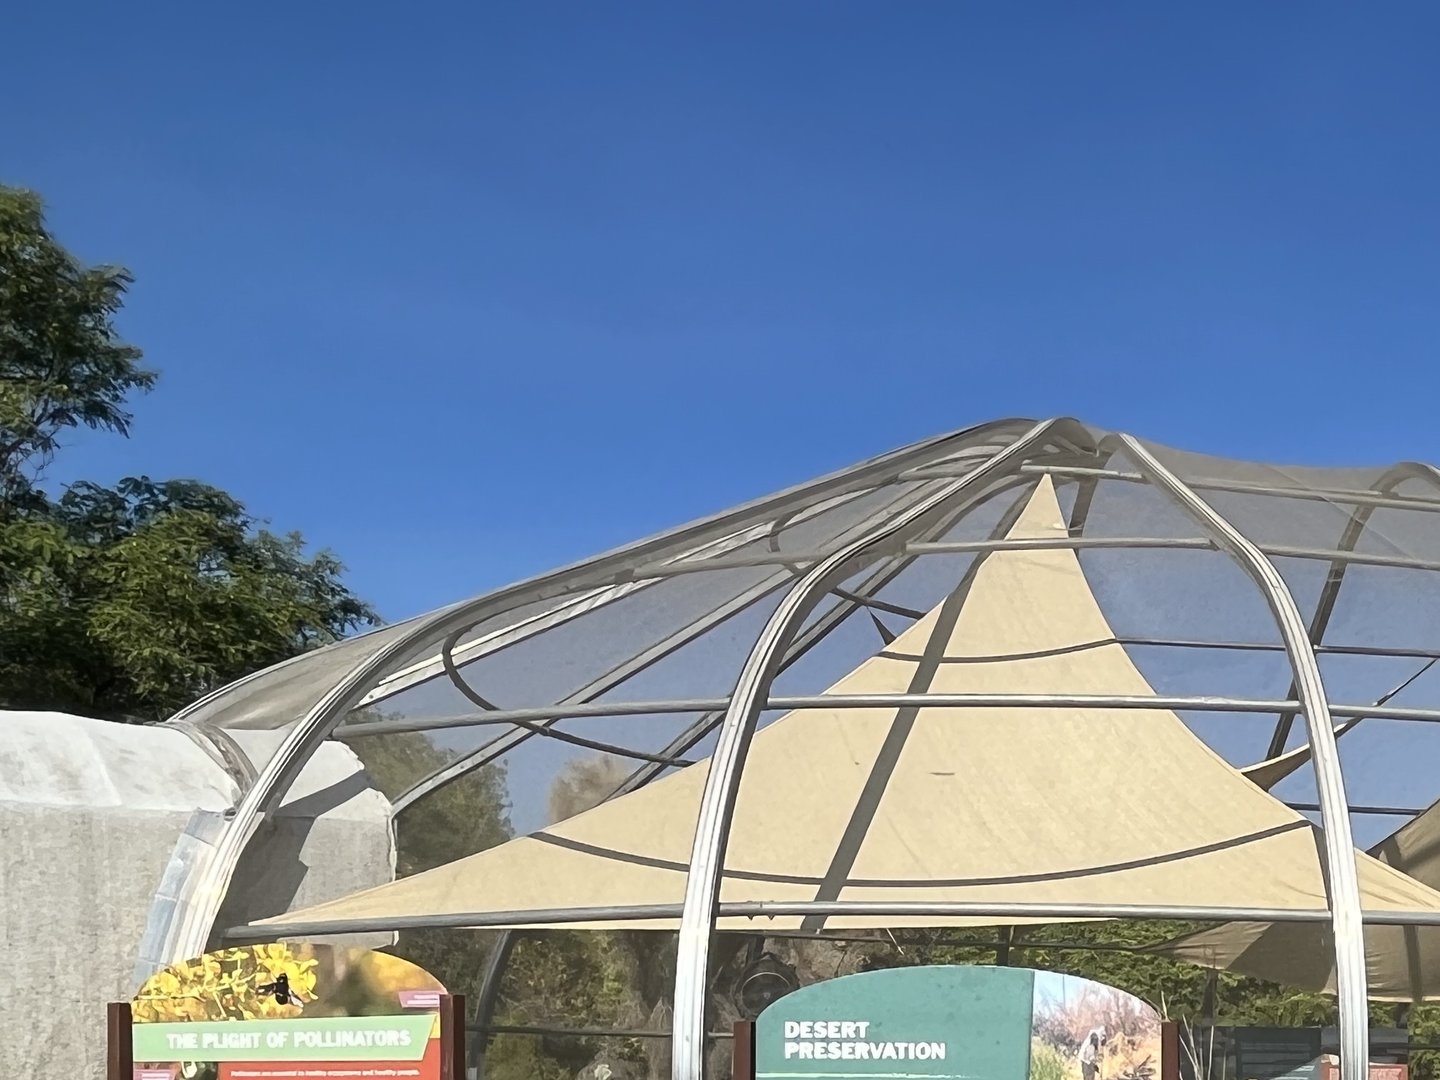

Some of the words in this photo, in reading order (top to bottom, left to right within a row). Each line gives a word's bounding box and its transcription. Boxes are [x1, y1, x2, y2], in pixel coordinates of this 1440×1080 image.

[784, 1021, 870, 1039] DESERT
[166, 1034, 198, 1049] THE
[202, 1032, 262, 1048] PLIGHT
[266, 1032, 288, 1048] OF
[294, 1030, 411, 1048] POLLINATORS
[784, 1042, 946, 1060] PRESERVATION
